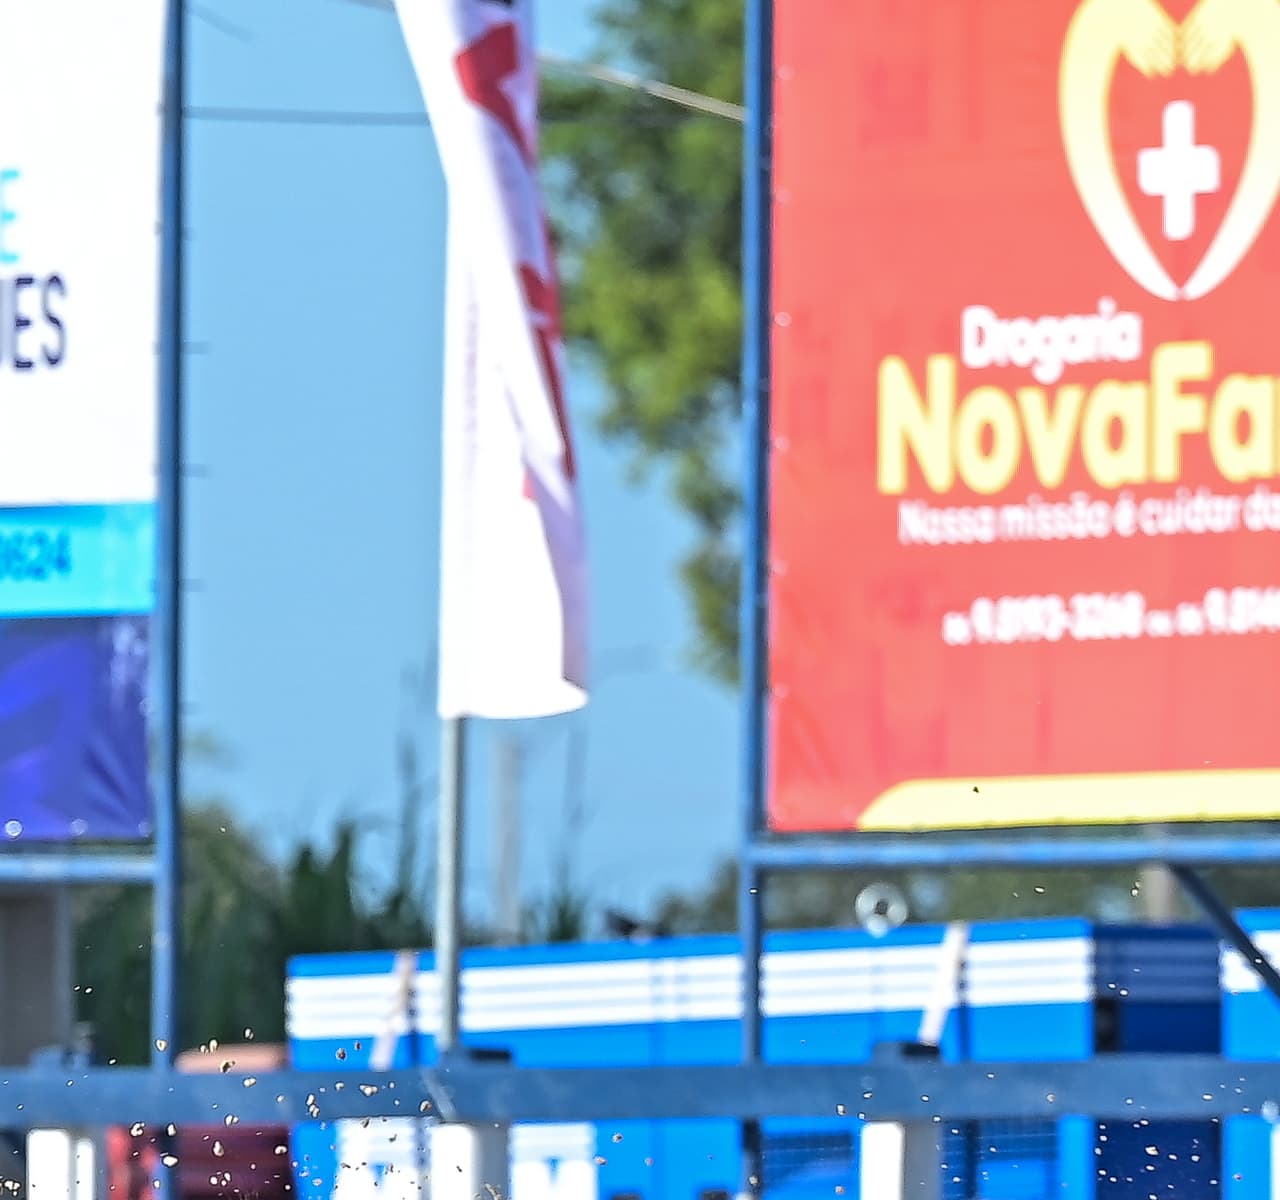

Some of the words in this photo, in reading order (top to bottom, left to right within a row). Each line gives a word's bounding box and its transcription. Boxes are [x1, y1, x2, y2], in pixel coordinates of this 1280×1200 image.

[962, 295, 1143, 384] Drogaria
[877, 340, 1280, 495] NovaFa
[898, 499, 997, 546] Nossa
[1000, 491, 1112, 541] missão
[1139, 486, 1243, 536] cuidar
